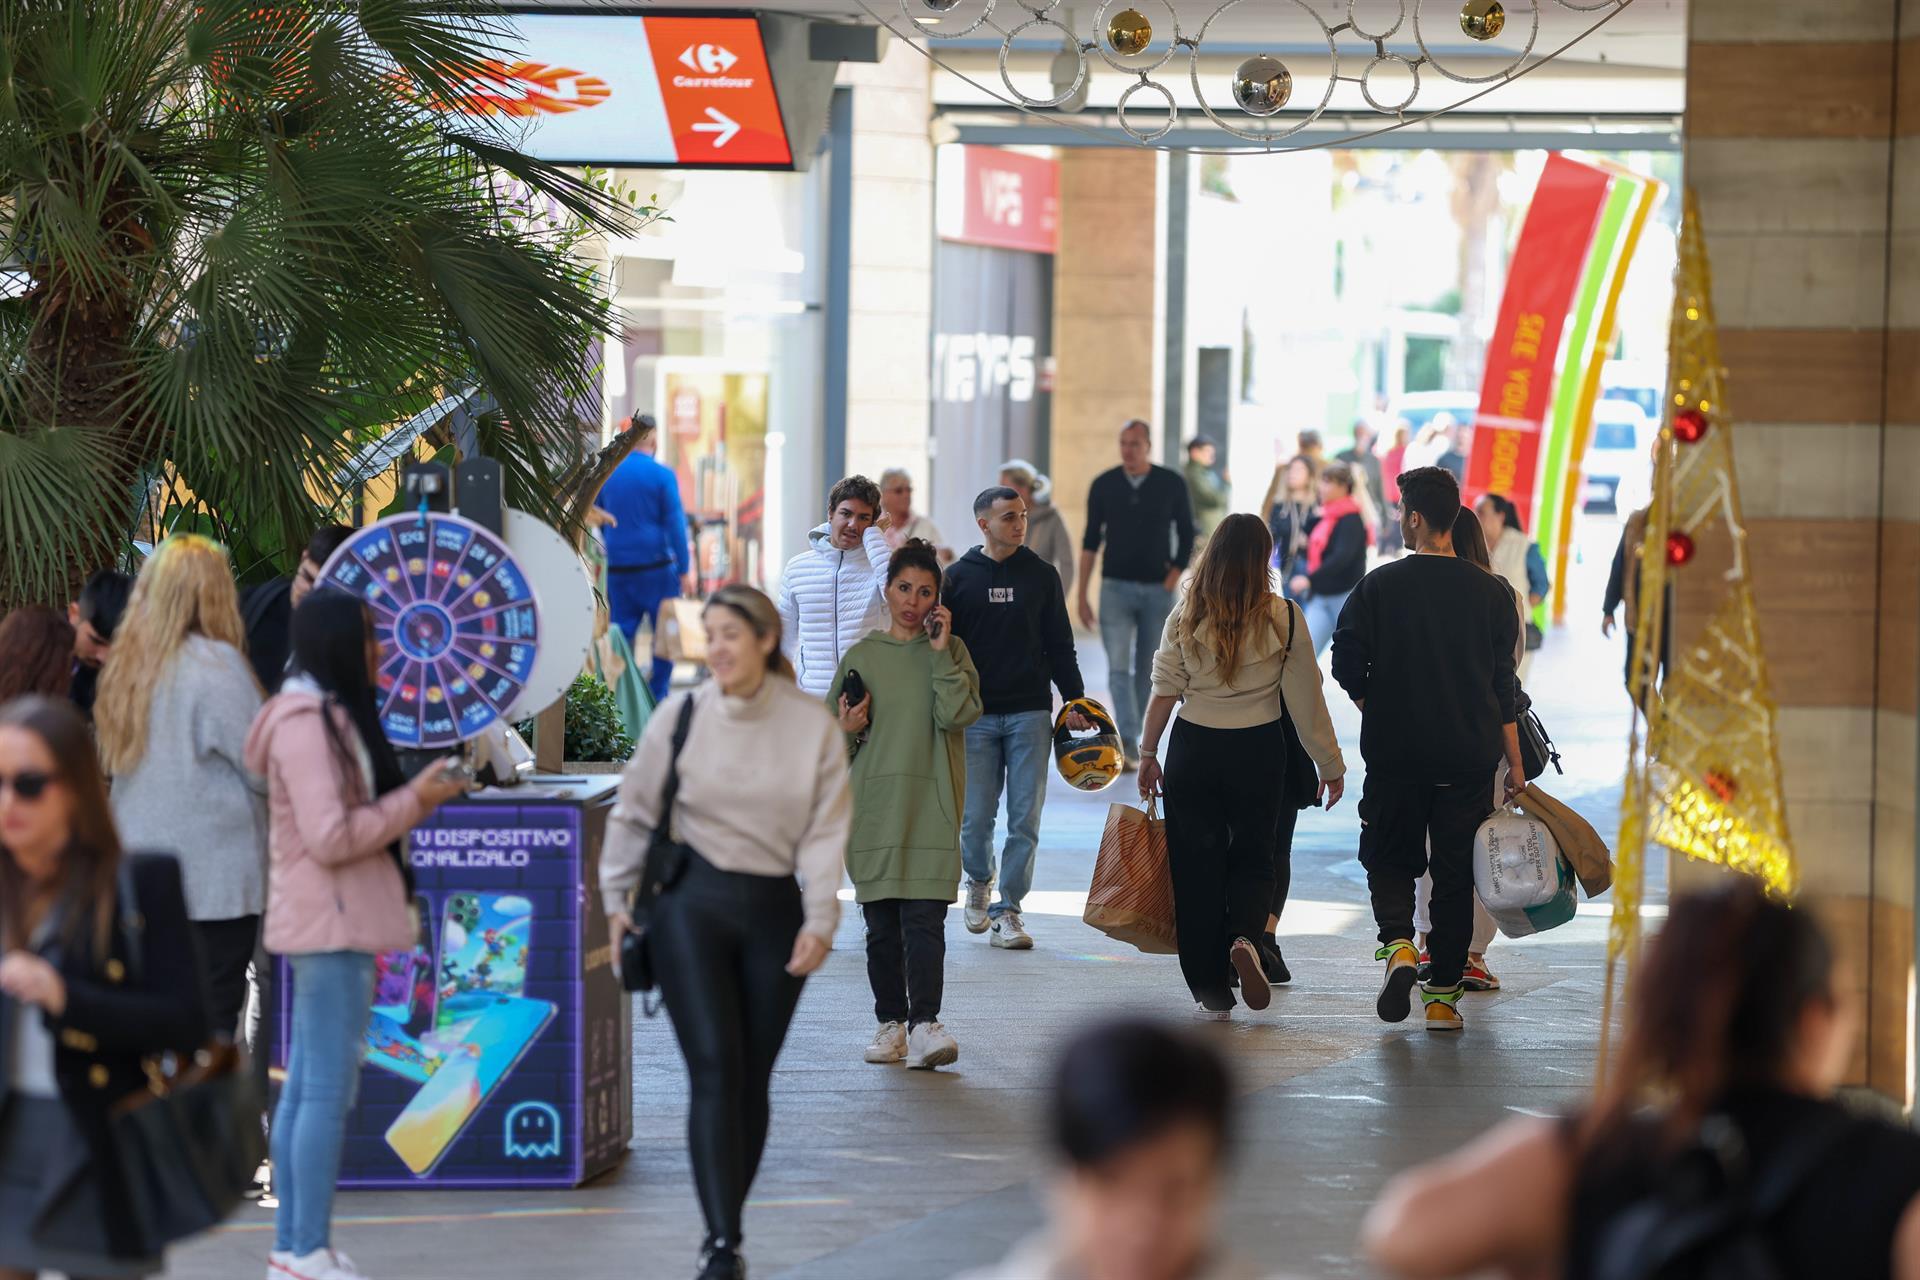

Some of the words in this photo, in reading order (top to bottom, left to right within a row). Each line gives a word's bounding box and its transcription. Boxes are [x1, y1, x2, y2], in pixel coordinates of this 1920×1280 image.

[673, 75, 753, 88] Carrefour
[1510, 312, 1545, 362] SEE
[411, 828, 431, 846] U
[434, 828, 571, 847] DISPOSITIVO
[1529, 822, 1537, 841] DUVET
[411, 850, 530, 867] ONALIZALO
